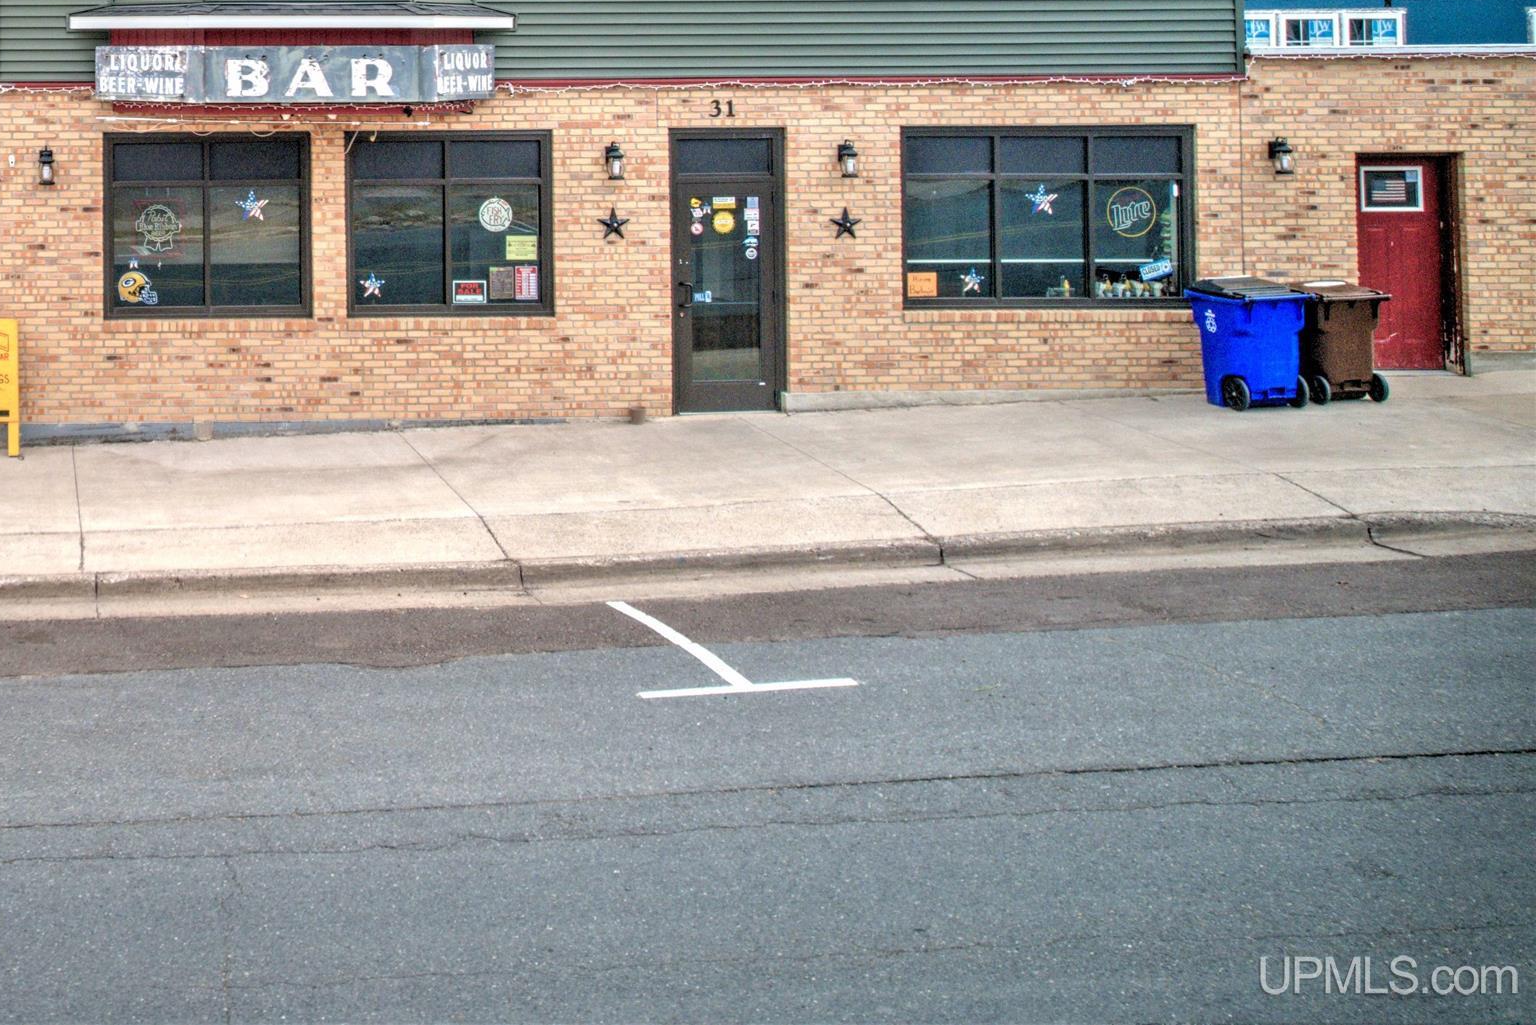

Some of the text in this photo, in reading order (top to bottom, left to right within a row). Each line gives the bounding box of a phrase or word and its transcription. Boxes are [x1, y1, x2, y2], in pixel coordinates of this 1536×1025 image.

[110, 53, 175, 72] LIQUOR
[444, 51, 488, 71] LIQUOR
[99, 76, 184, 94] BEER-WINE
[226, 57, 395, 97] BAR
[436, 74, 493, 94] BEER-WINE
[709, 99, 736, 117] 31
[486, 206, 503, 216] FISH
